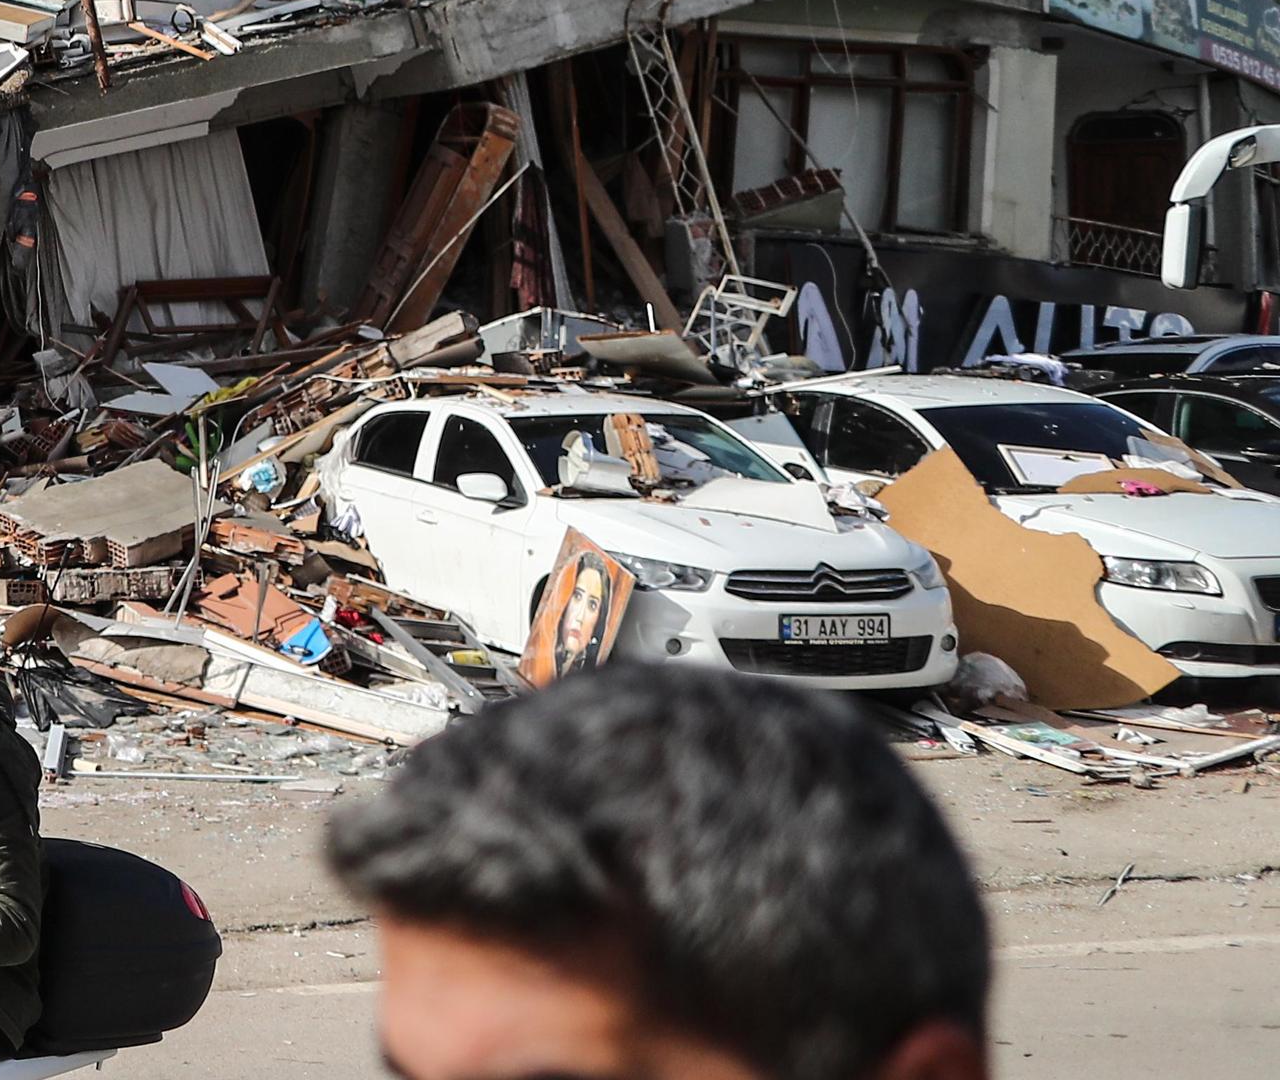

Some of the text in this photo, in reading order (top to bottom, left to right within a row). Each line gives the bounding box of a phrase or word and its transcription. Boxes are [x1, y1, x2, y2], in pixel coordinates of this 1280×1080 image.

[793, 618, 885, 637] 31 AAY 994
